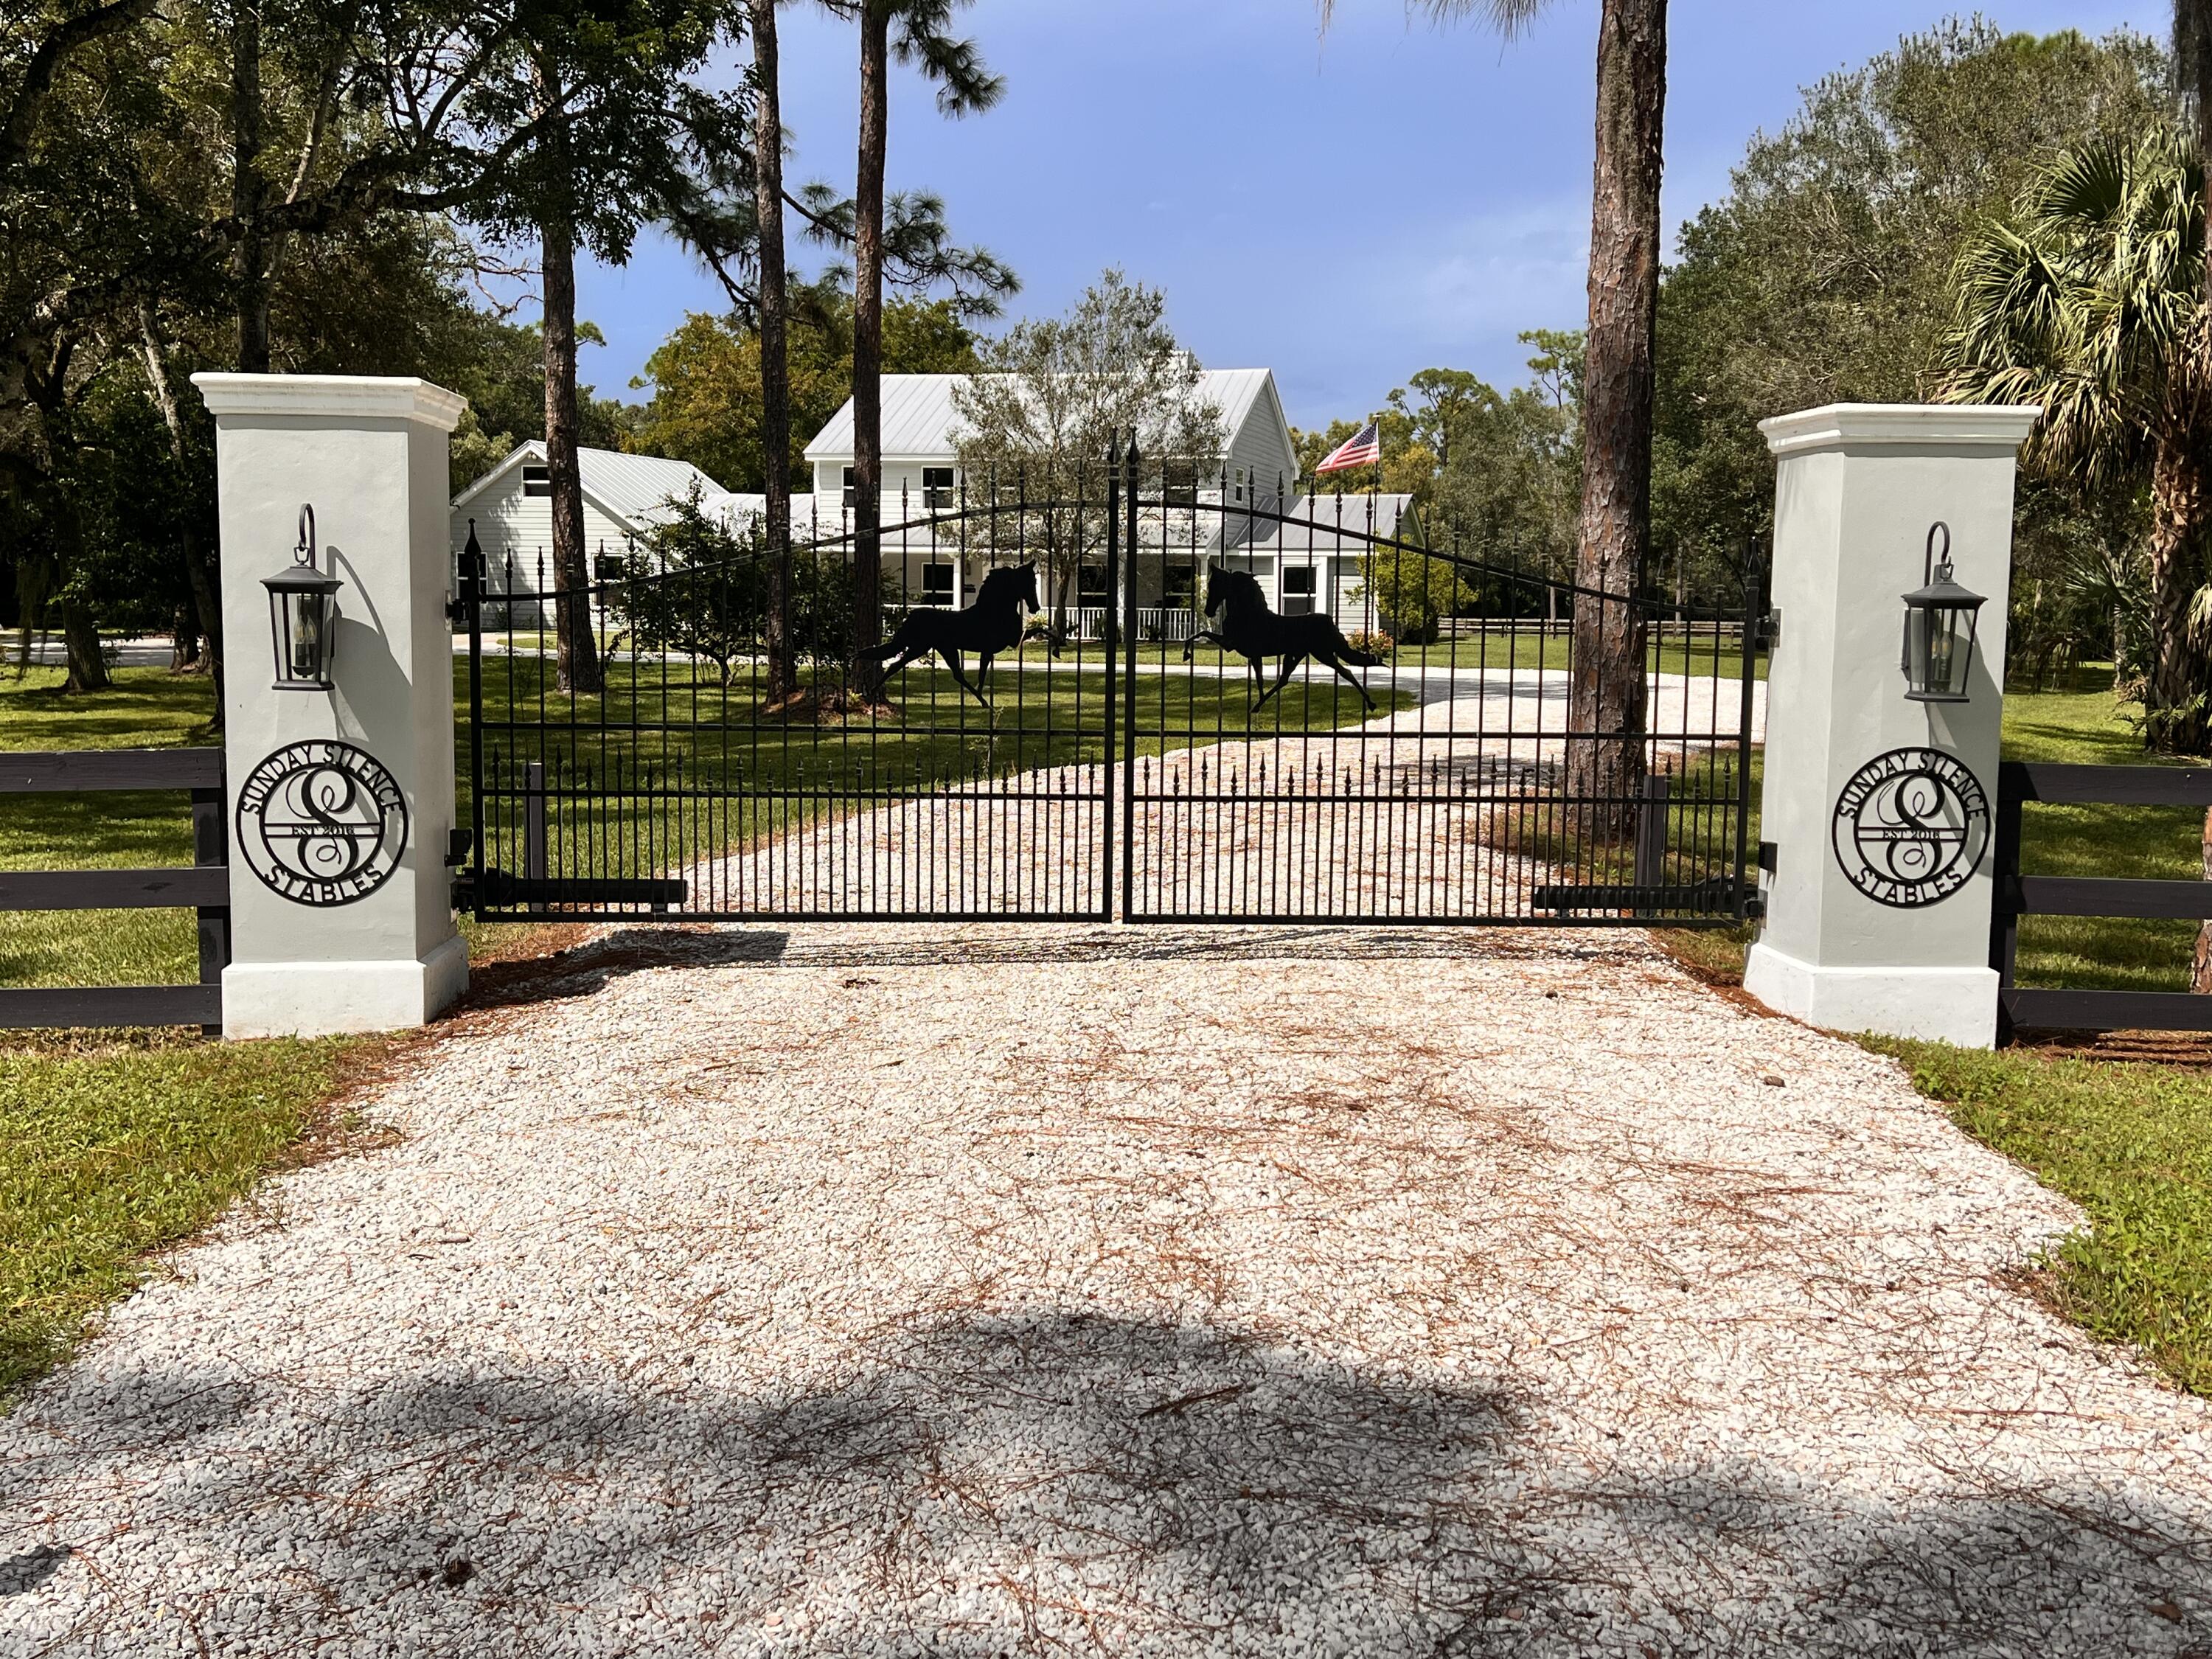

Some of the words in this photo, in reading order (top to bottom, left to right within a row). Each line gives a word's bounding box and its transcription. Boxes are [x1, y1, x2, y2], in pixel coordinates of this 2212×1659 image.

[240, 743, 312, 815] SUNDAY
[322, 743, 403, 815] SILENCE
[1839, 751, 1909, 820] SUNDAY
[1918, 751, 1987, 820] SILENCE
[292, 824, 319, 836] EST
[1882, 828, 1907, 840] EST
[264, 863, 385, 903] STABLES
[1854, 866, 1964, 904] STABLES
